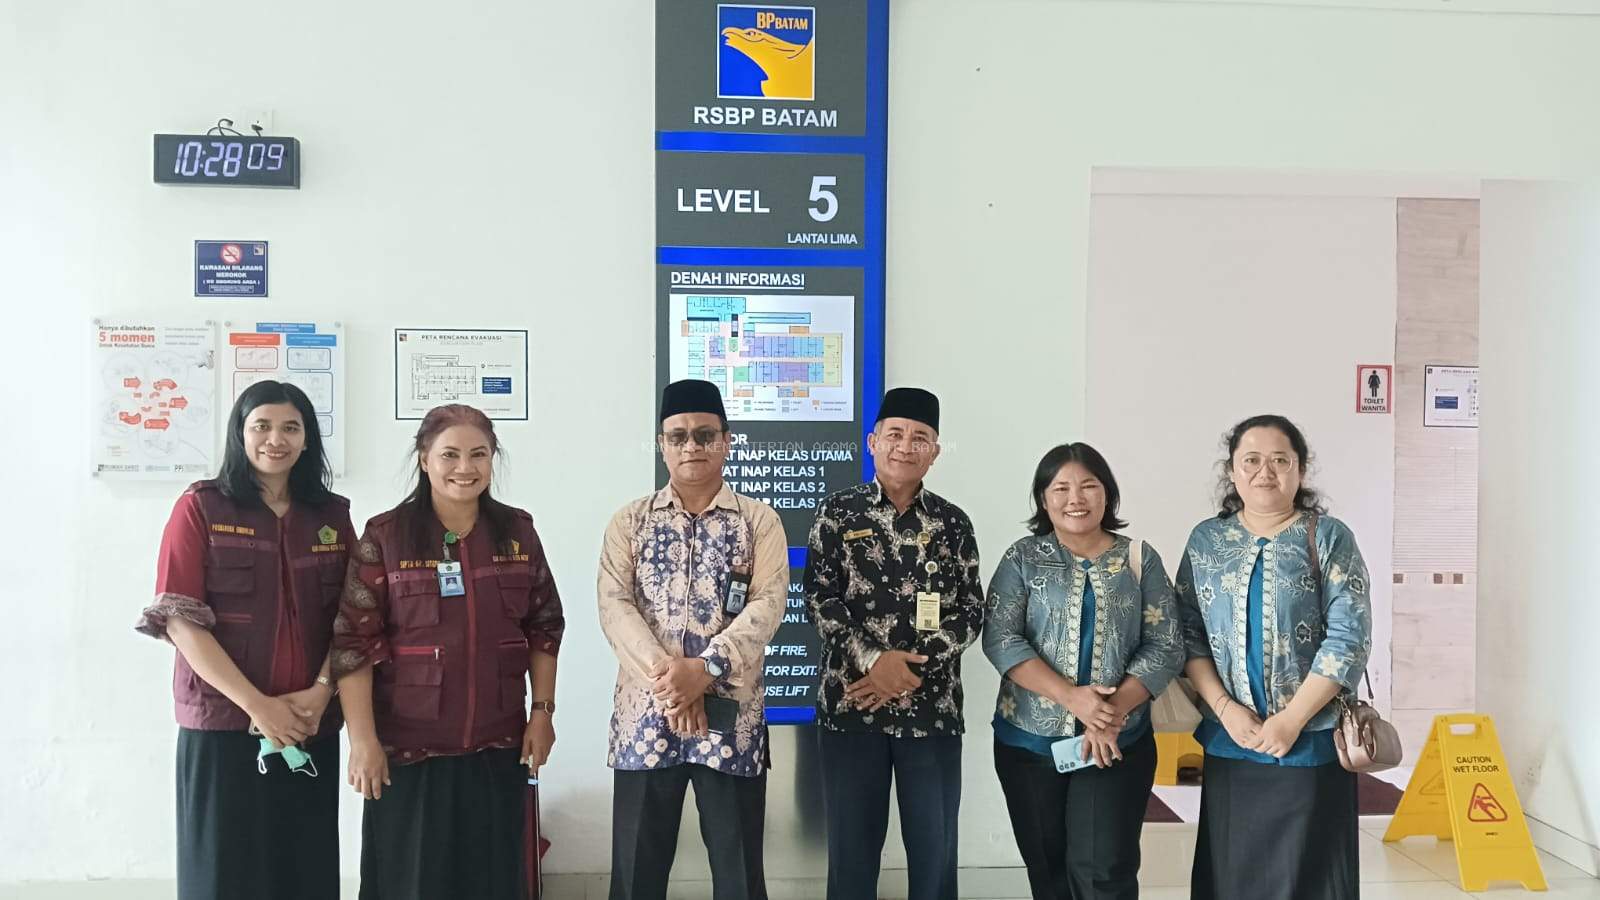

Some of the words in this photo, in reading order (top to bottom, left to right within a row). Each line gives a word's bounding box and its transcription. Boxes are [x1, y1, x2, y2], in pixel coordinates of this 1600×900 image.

[694, 106, 755, 125] RSBP
[762, 110, 838, 128] BATAM
[174, 142, 242, 177] 10:28
[246, 144, 284, 170] 09
[677, 188, 770, 213] LEVEL
[808, 176, 838, 222] 5
[788, 232, 828, 244] LANTAI
[830, 233, 858, 244] LIMA
[670, 272, 721, 284] DENAH
[726, 272, 804, 286] INFORMASI
[99, 332, 106, 342] 5
[110, 334, 155, 342] momen
[738, 450, 766, 461] INAP
[768, 450, 809, 461] KELAS
[811, 450, 853, 461] UTAMA
[742, 466, 770, 477] INAP
[774, 466, 816, 477] KELAS
[819, 466, 825, 477] 1
[742, 482, 770, 492] INAP
[774, 482, 816, 493] KELAS
[818, 482, 826, 492] 2
[774, 498, 816, 509] KELAS
[780, 646, 808, 657] FIRE,
[764, 666, 790, 676] FOR
[791, 666, 817, 676] EXIT.
[785, 686, 810, 696] LIFT
